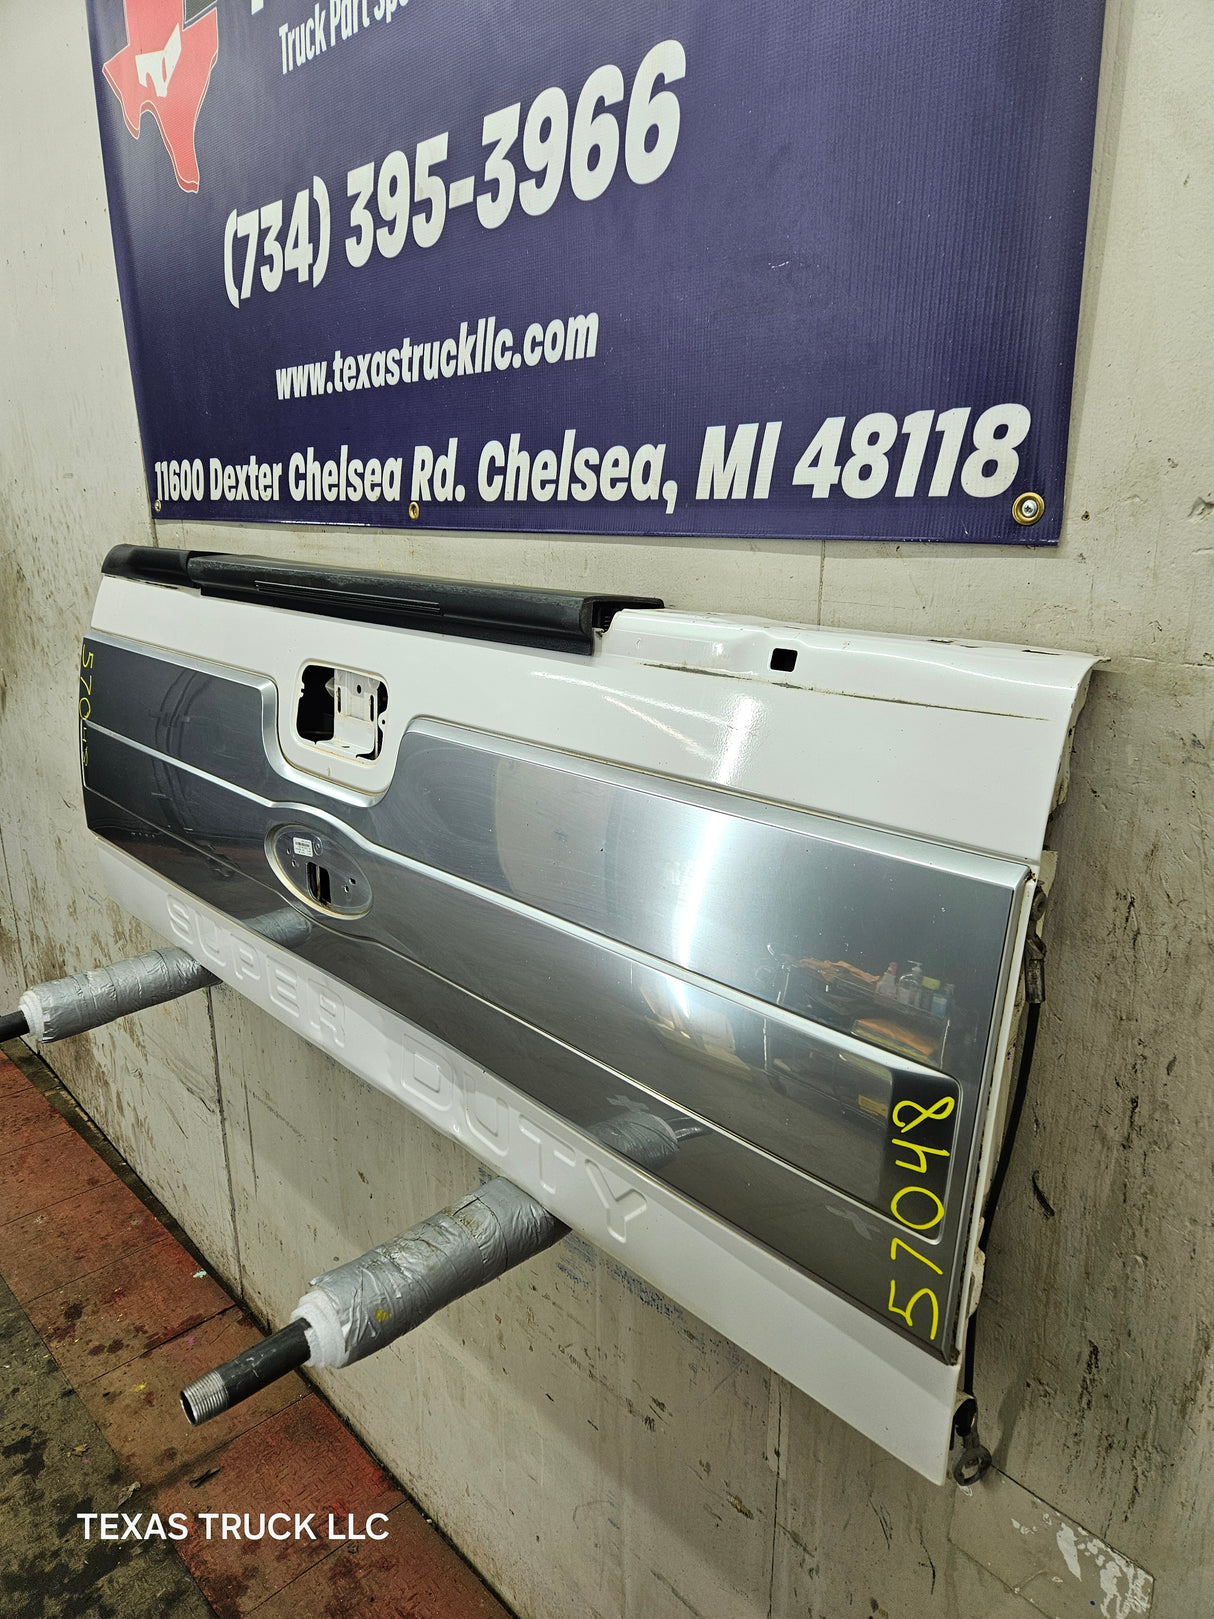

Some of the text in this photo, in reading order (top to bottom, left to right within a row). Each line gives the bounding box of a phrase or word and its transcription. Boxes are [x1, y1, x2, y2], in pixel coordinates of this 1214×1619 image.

[278, 0, 371, 75] Truck Part
[224, 39, 686, 308] (734) 395-3966
[275, 312, 599, 400] www.texastruckllc.com
[154, 403, 1032, 514] 11600 Dexter Chelsea Rd. Chelsea, MI 48118
[166, 893, 648, 1244] SUPER DUTY
[888, 1096, 955, 1341] 57048
